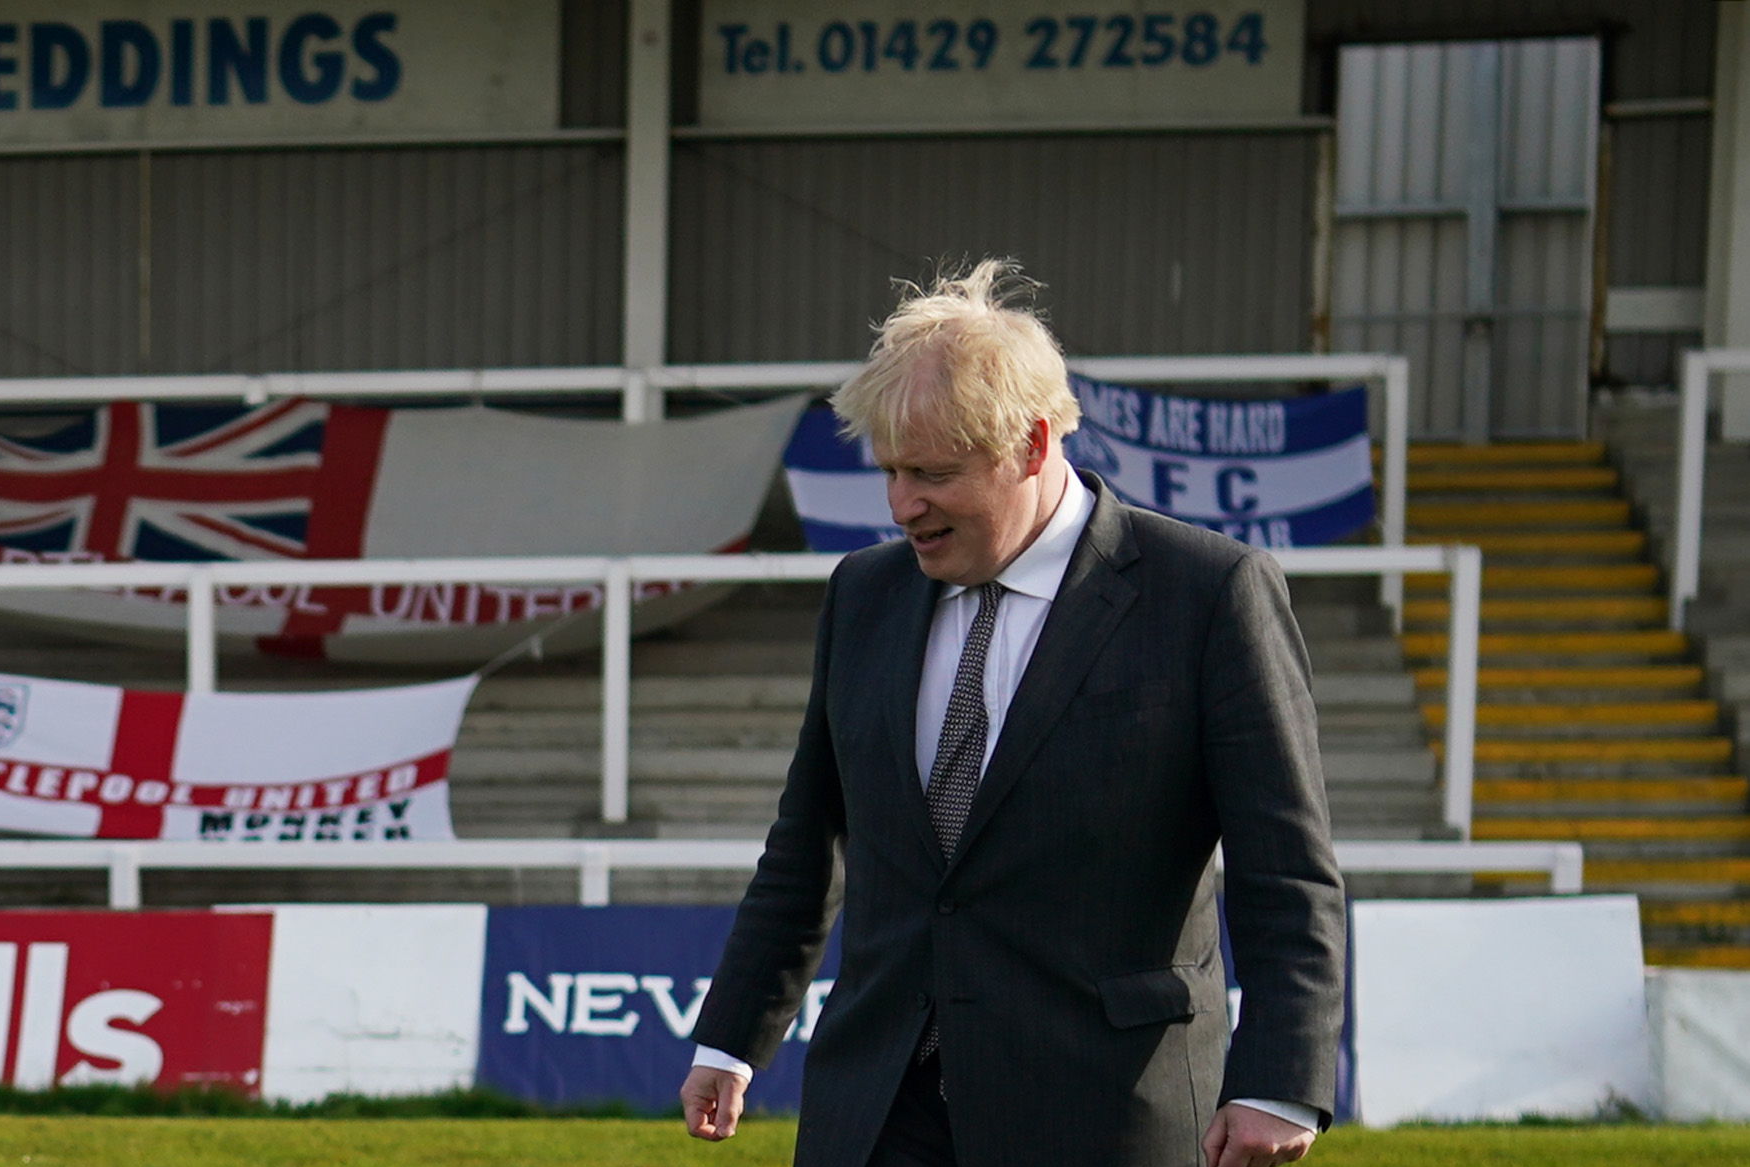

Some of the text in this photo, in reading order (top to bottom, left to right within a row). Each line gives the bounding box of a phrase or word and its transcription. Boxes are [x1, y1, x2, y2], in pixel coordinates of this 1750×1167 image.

[1023, 10, 1271, 72] 272584
[1147, 395, 1203, 453] ARE
[1206, 400, 1287, 455] HARD
[223, 762, 417, 810] UNITED
[200, 798, 409, 834] MONKEY
